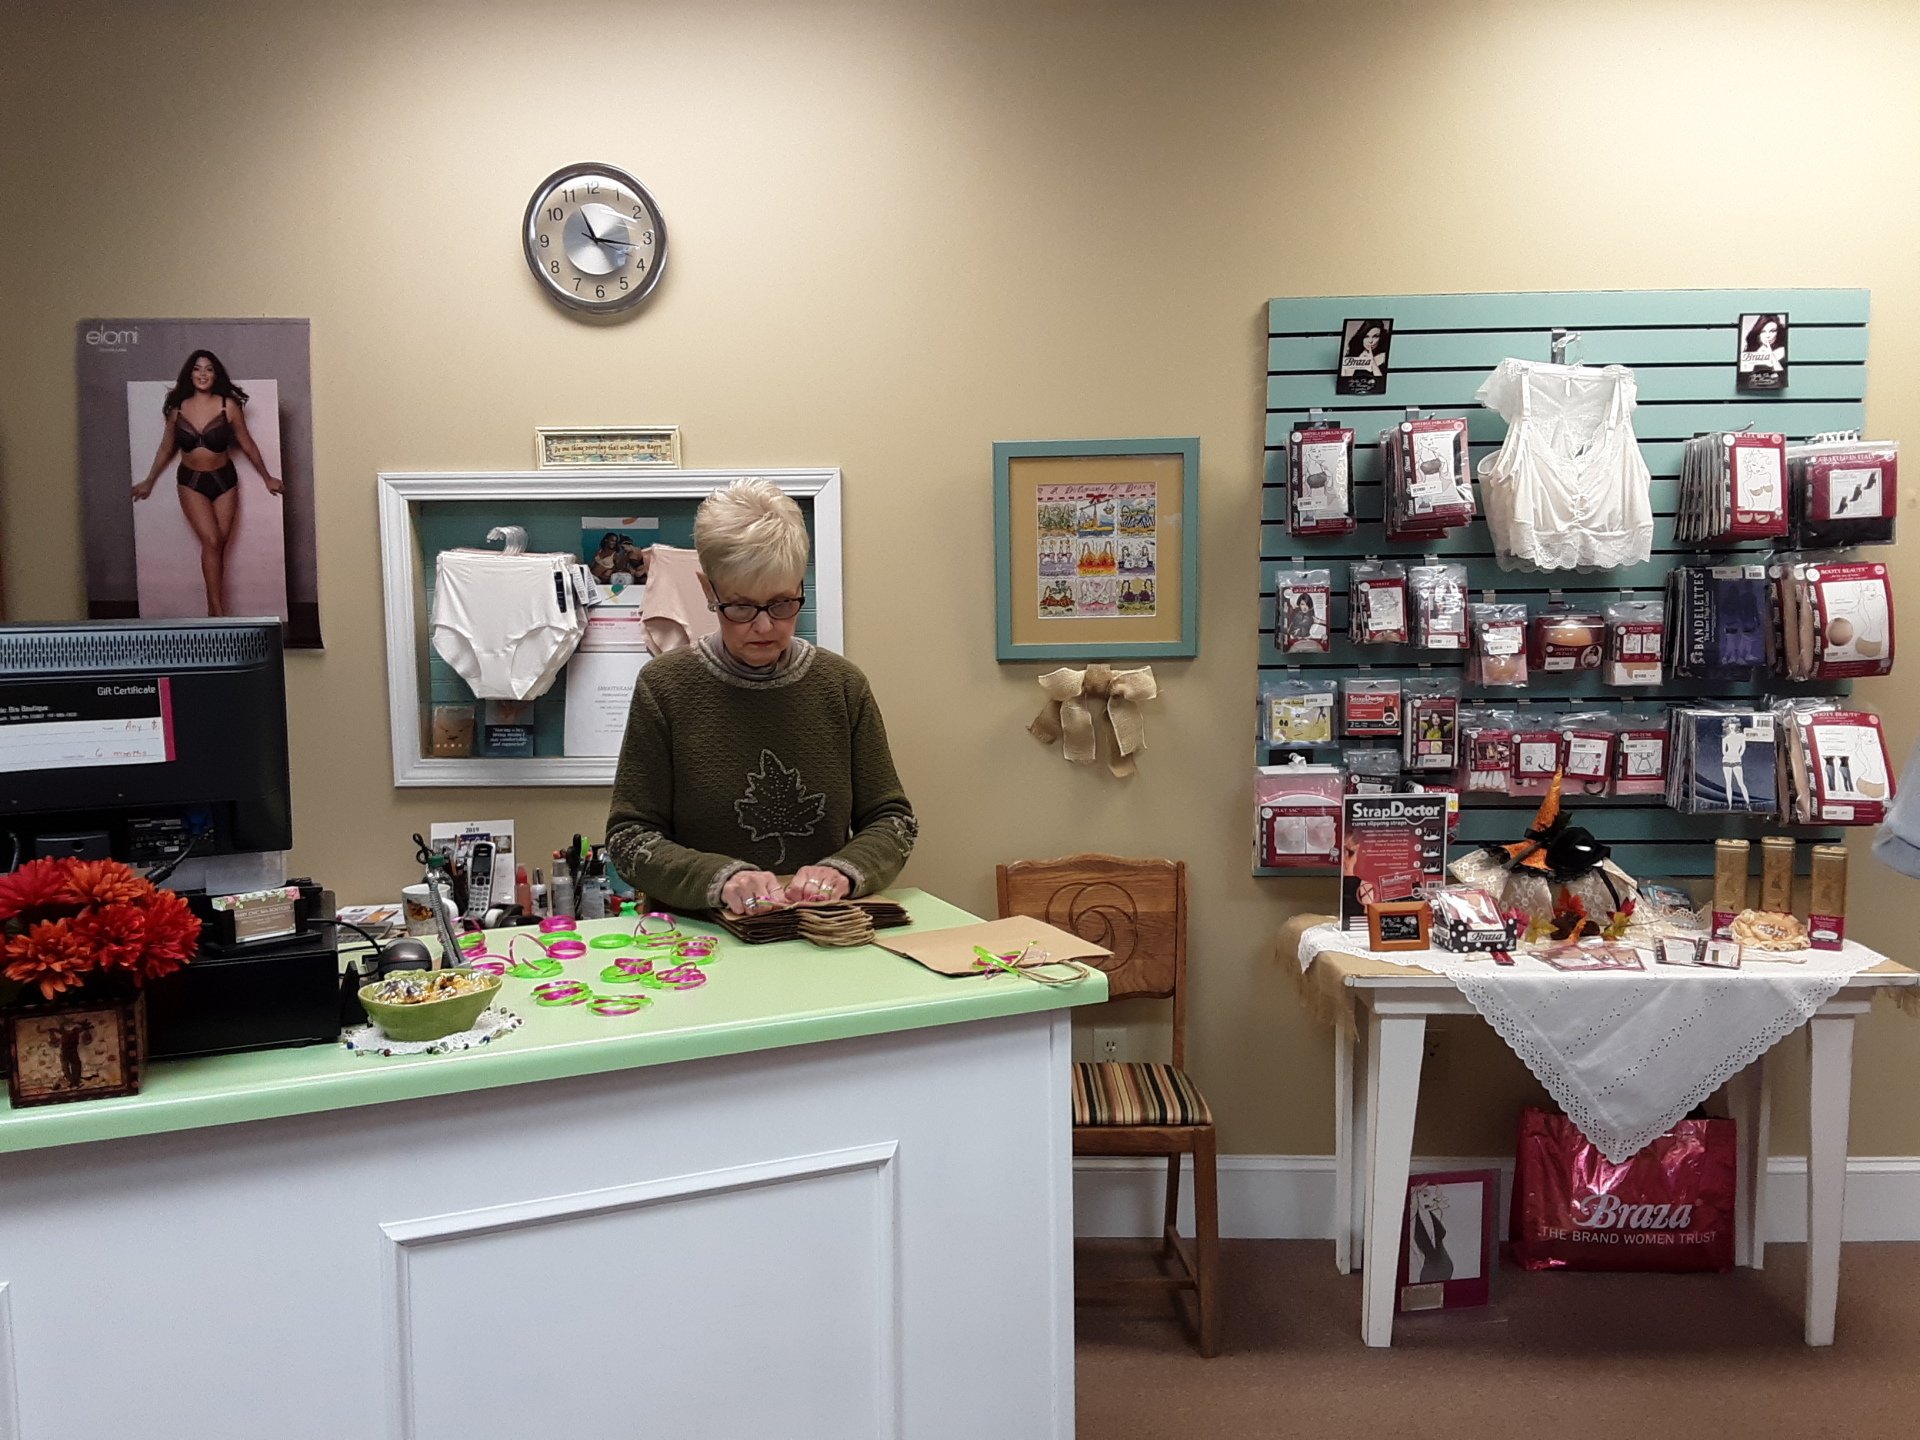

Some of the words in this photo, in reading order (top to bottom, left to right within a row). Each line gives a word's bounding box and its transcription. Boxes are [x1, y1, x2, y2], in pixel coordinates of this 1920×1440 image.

[585, 181, 601, 195] 12
[615, 187, 620, 201] 1
[561, 189, 576, 203] 11
[546, 207, 564, 221] 10
[631, 205, 642, 219] 2
[539, 234, 550, 248] 9
[642, 231, 653, 245] 3
[550, 260, 560, 274] 8
[636, 258, 646, 272] 4
[572, 277, 582, 291] 7
[619, 276, 629, 290] 5
[595, 284, 606, 298] 6
[86, 322, 138, 345] elomi
[1693, 573, 1704, 650] BANDELETTES
[97, 687, 112, 696] Gift
[114, 685, 156, 695] Certificate
[1352, 801, 1440, 819] StrapDoctor
[1471, 932, 1504, 941] Braza
[1572, 1193, 1693, 1229] Braza
[1541, 1227, 1567, 1241] THE
[1572, 1231, 1619, 1244] BRAND
[1624, 1232, 1675, 1245] WOMEN
[1679, 1231, 1717, 1244] TRUST
